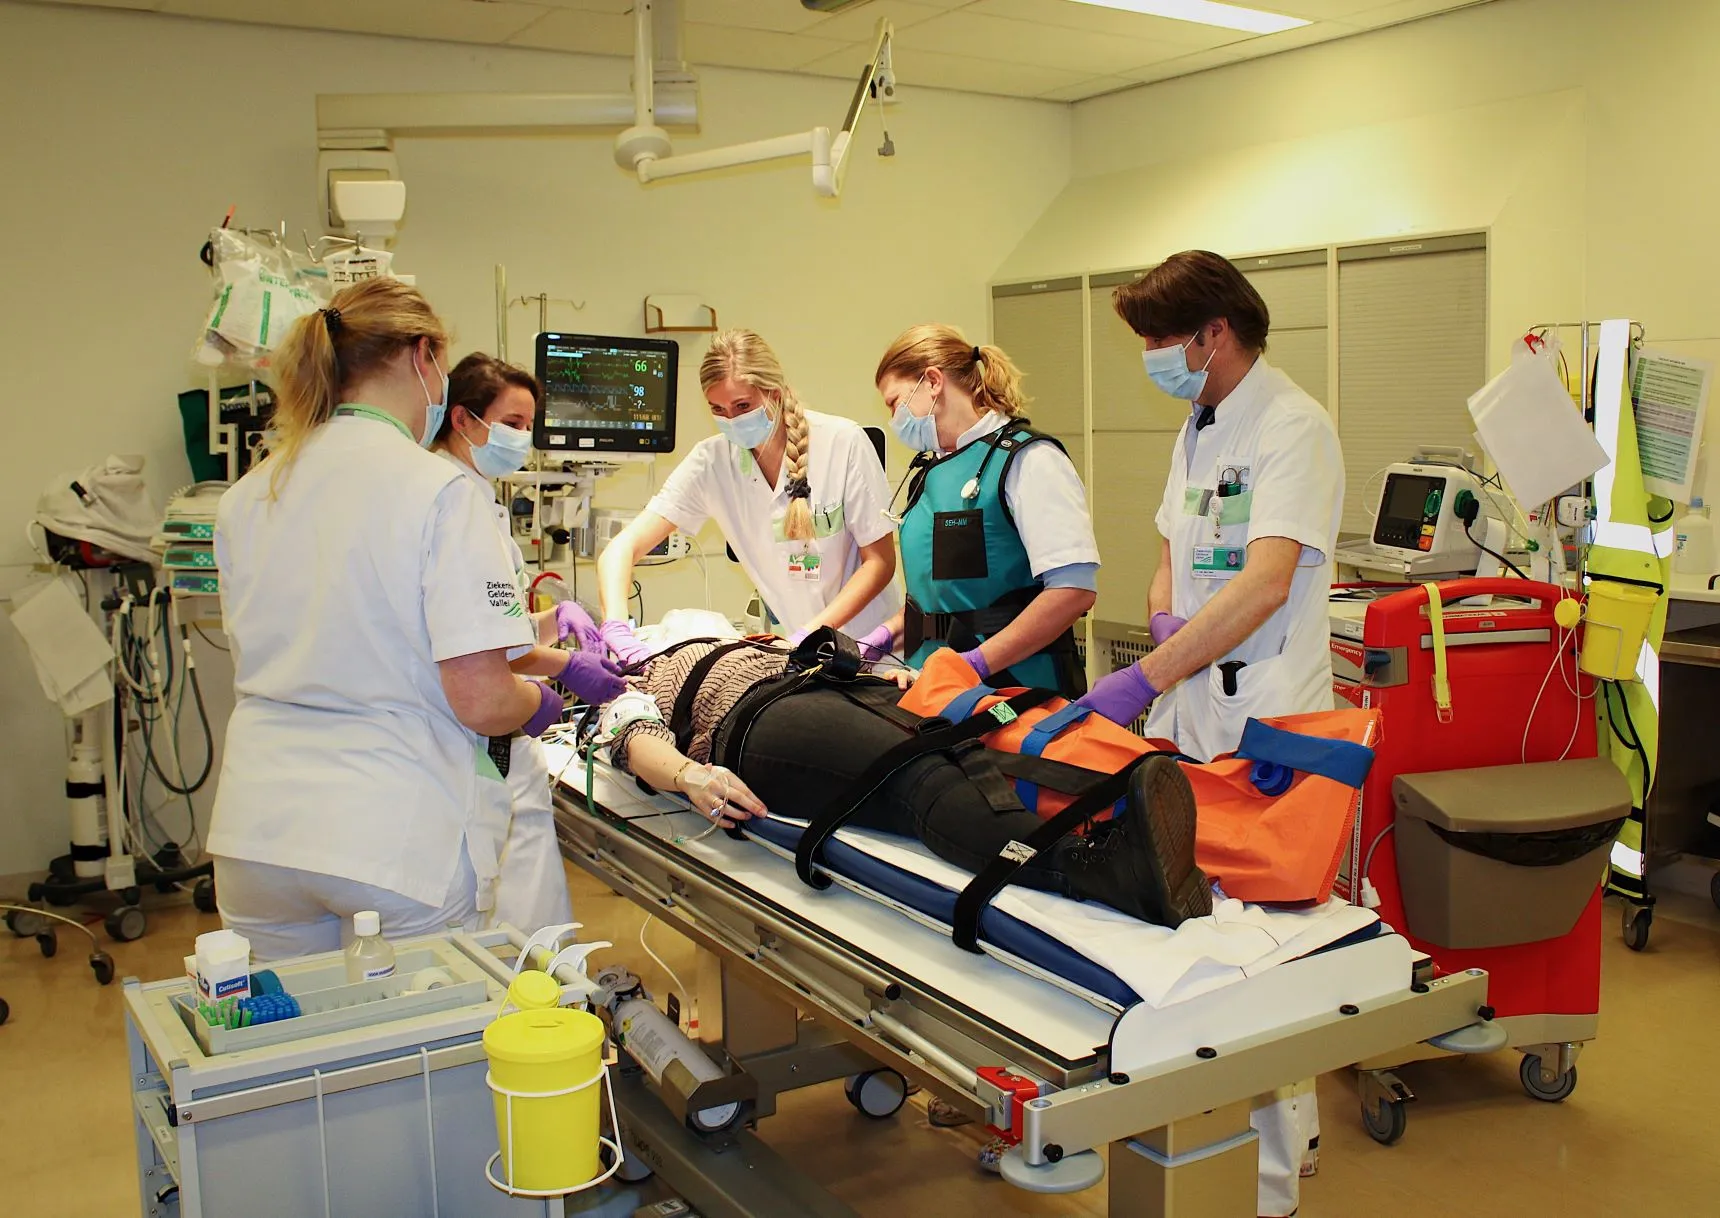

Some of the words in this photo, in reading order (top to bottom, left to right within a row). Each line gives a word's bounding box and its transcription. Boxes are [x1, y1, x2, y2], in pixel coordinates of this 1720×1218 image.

[634, 360, 647, 372] 66
[633, 386, 645, 397] 98
[486, 581, 514, 590] Zieken
[490, 599, 510, 607] Vallei
[1331, 642, 1363, 656] Emergency
[218, 980, 243, 992] Cutisoft
